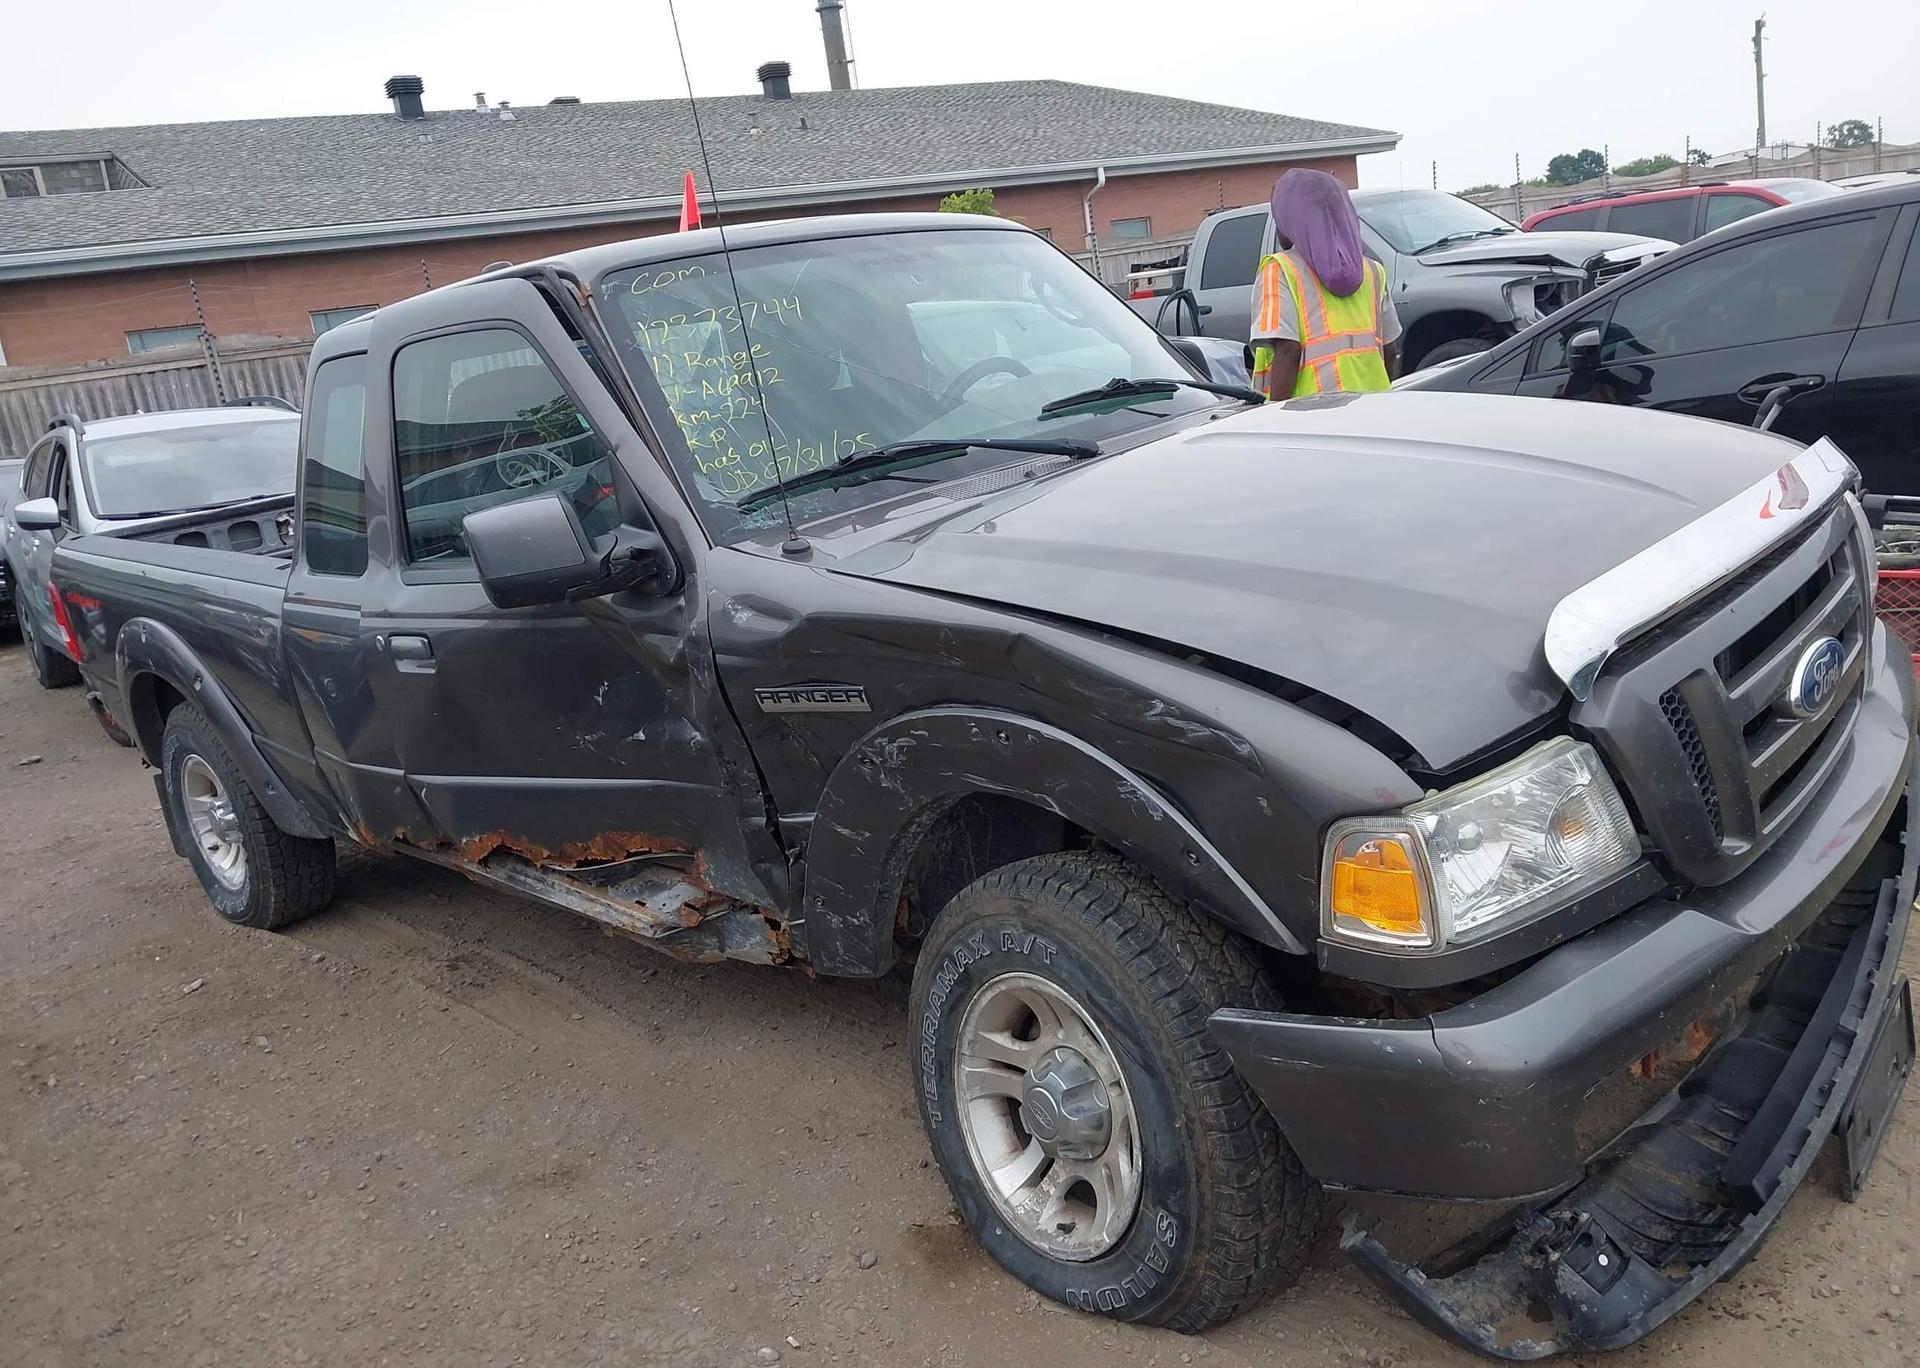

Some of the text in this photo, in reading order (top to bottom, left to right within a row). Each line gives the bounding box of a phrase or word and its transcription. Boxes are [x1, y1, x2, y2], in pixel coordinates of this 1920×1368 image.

[757, 689, 866, 705] RANGER
[921, 929, 1057, 1129] TERRAMAX A/T
[1065, 1209, 1177, 1313] SAILUN
